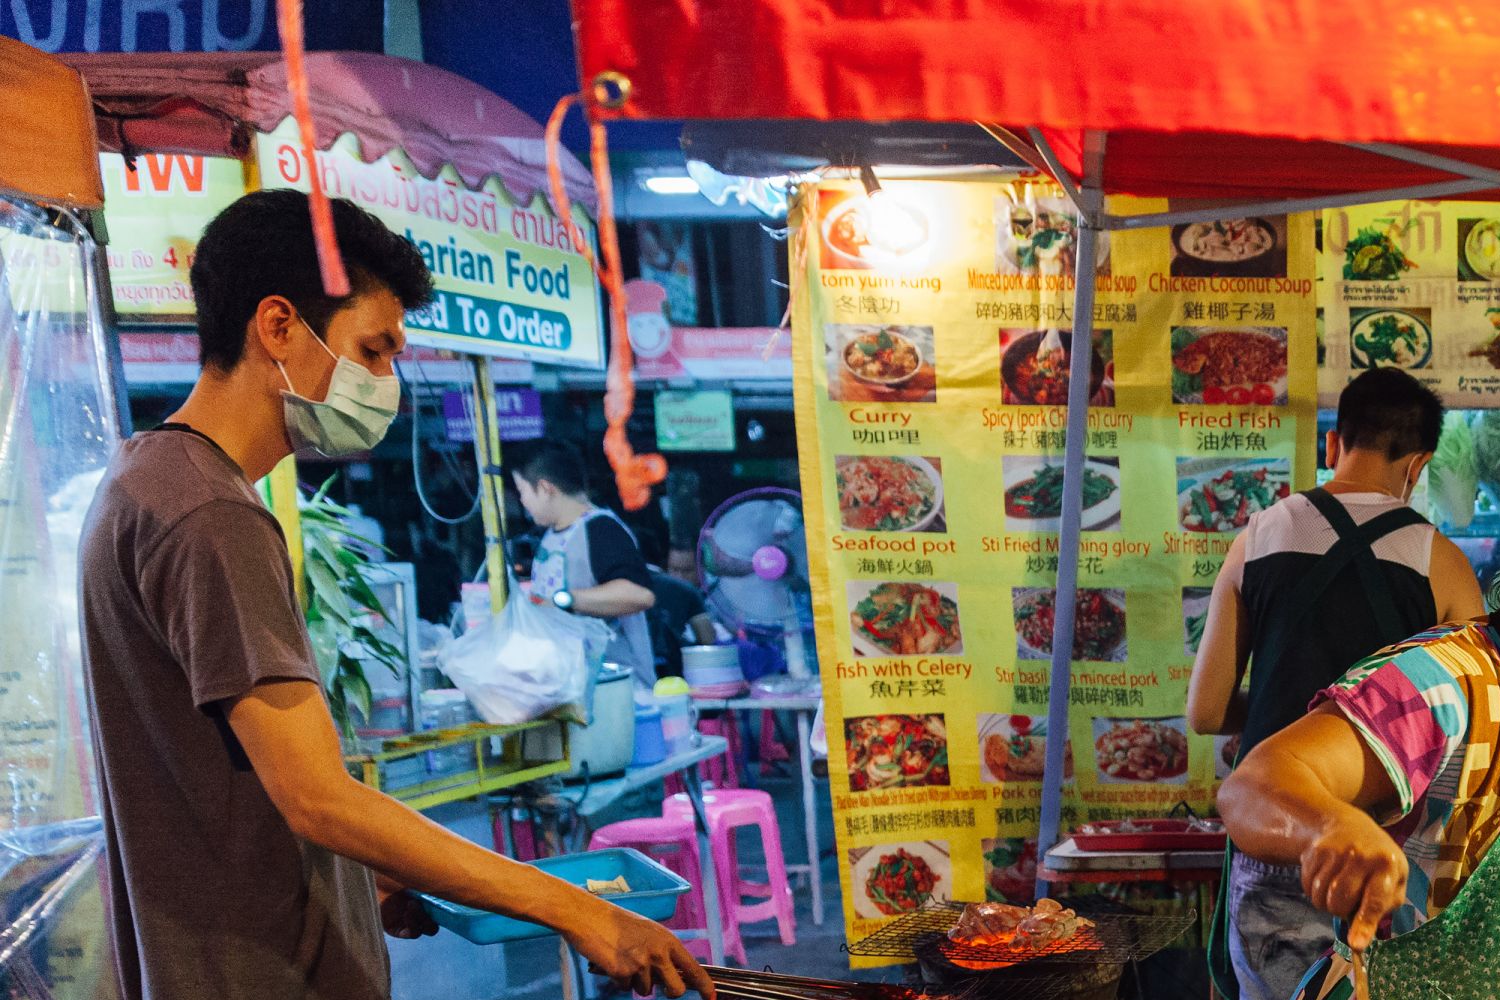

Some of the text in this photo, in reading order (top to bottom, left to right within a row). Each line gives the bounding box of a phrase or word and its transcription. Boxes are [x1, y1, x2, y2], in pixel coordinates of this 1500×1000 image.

[163, 247, 178, 269] 4
[505, 249, 570, 300] Food
[821, 274, 942, 294] tom yum kung
[968, 268, 1000, 291] Minced
[1003, 270, 1024, 296] pork
[1026, 268, 1041, 291] and
[1045, 273, 1065, 297] soya
[1114, 275, 1136, 297] soup
[1149, 273, 1312, 298] Chicken Coconut Soup
[456, 296, 490, 336] To
[498, 304, 564, 347] Order
[976, 302, 1137, 322] 碎的豬肉和大豆腐湯
[1184, 303, 1276, 321] 雞椰子湯
[849, 408, 912, 428] Curry
[982, 408, 1014, 431] Spicy
[1017, 408, 1047, 433] (pork
[1103, 413, 1133, 433] curry
[1178, 411, 1281, 429] Fried Fish
[1196, 431, 1267, 451] 油炸魚
[832, 535, 957, 556] Seafood pot
[982, 536, 1151, 558] Sti Fried Mning glory
[857, 558, 934, 576] 海鮮火鍋
[836, 659, 972, 680] fish with Celery
[995, 665, 1015, 684] Stir
[1018, 667, 1048, 685] basil
[1079, 669, 1126, 686] minced
[1129, 670, 1159, 689] pork
[869, 679, 946, 698] 魚芹菜
[992, 785, 1025, 800] Pork
